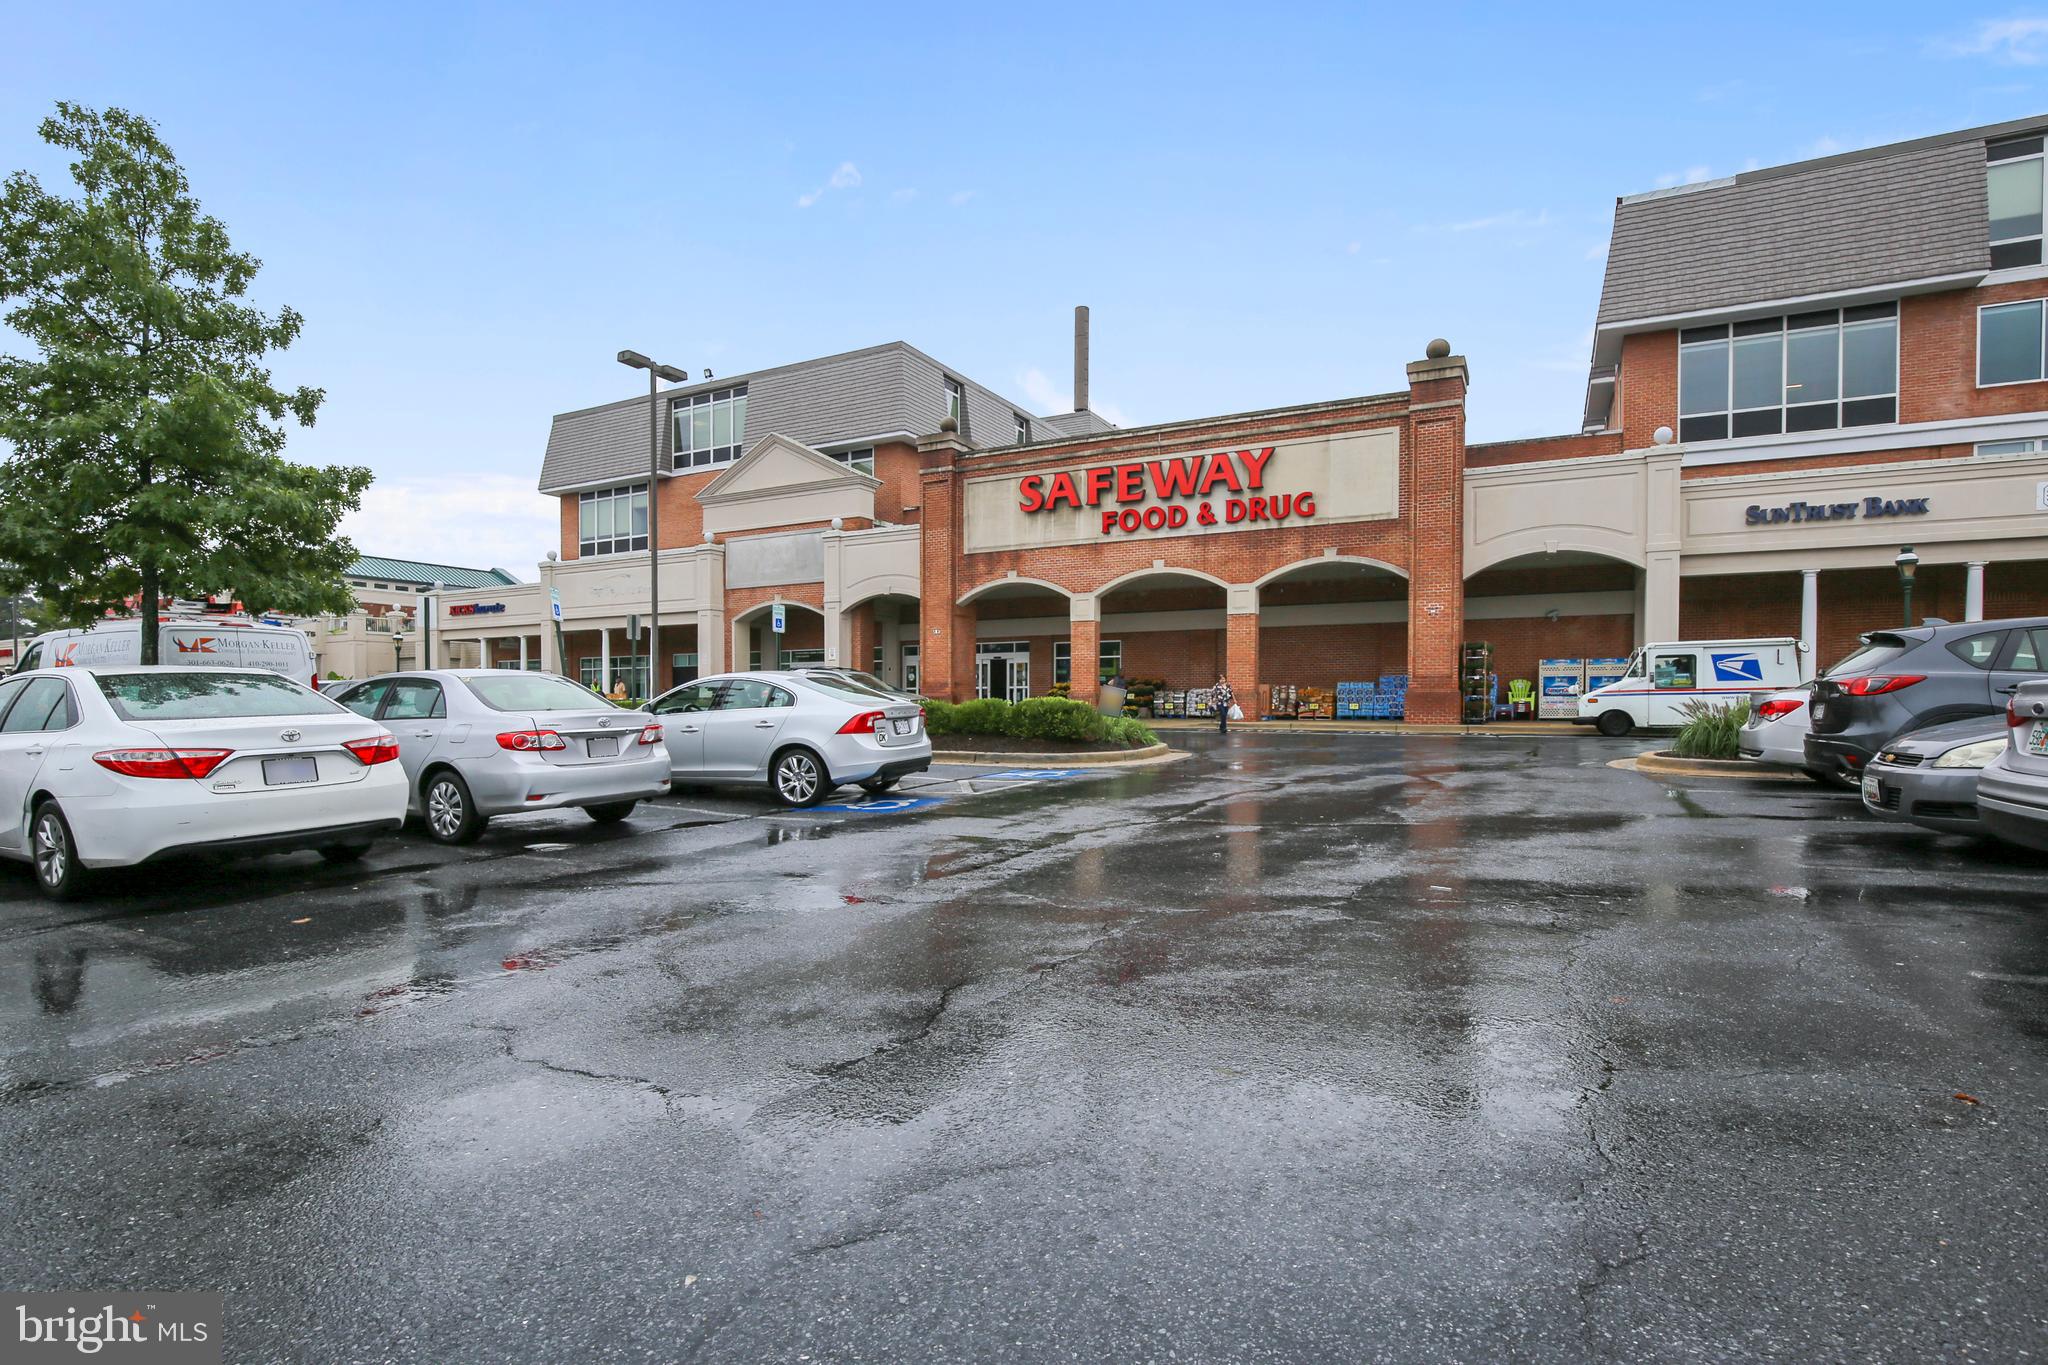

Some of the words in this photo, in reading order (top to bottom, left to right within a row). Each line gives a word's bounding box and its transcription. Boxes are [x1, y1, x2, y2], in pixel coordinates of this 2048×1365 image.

[1019, 447, 1276, 513] SAFEWAY
[1101, 504, 1188, 534] FOOD
[1196, 501, 1218, 525] &
[1226, 491, 1316, 523] DRUG
